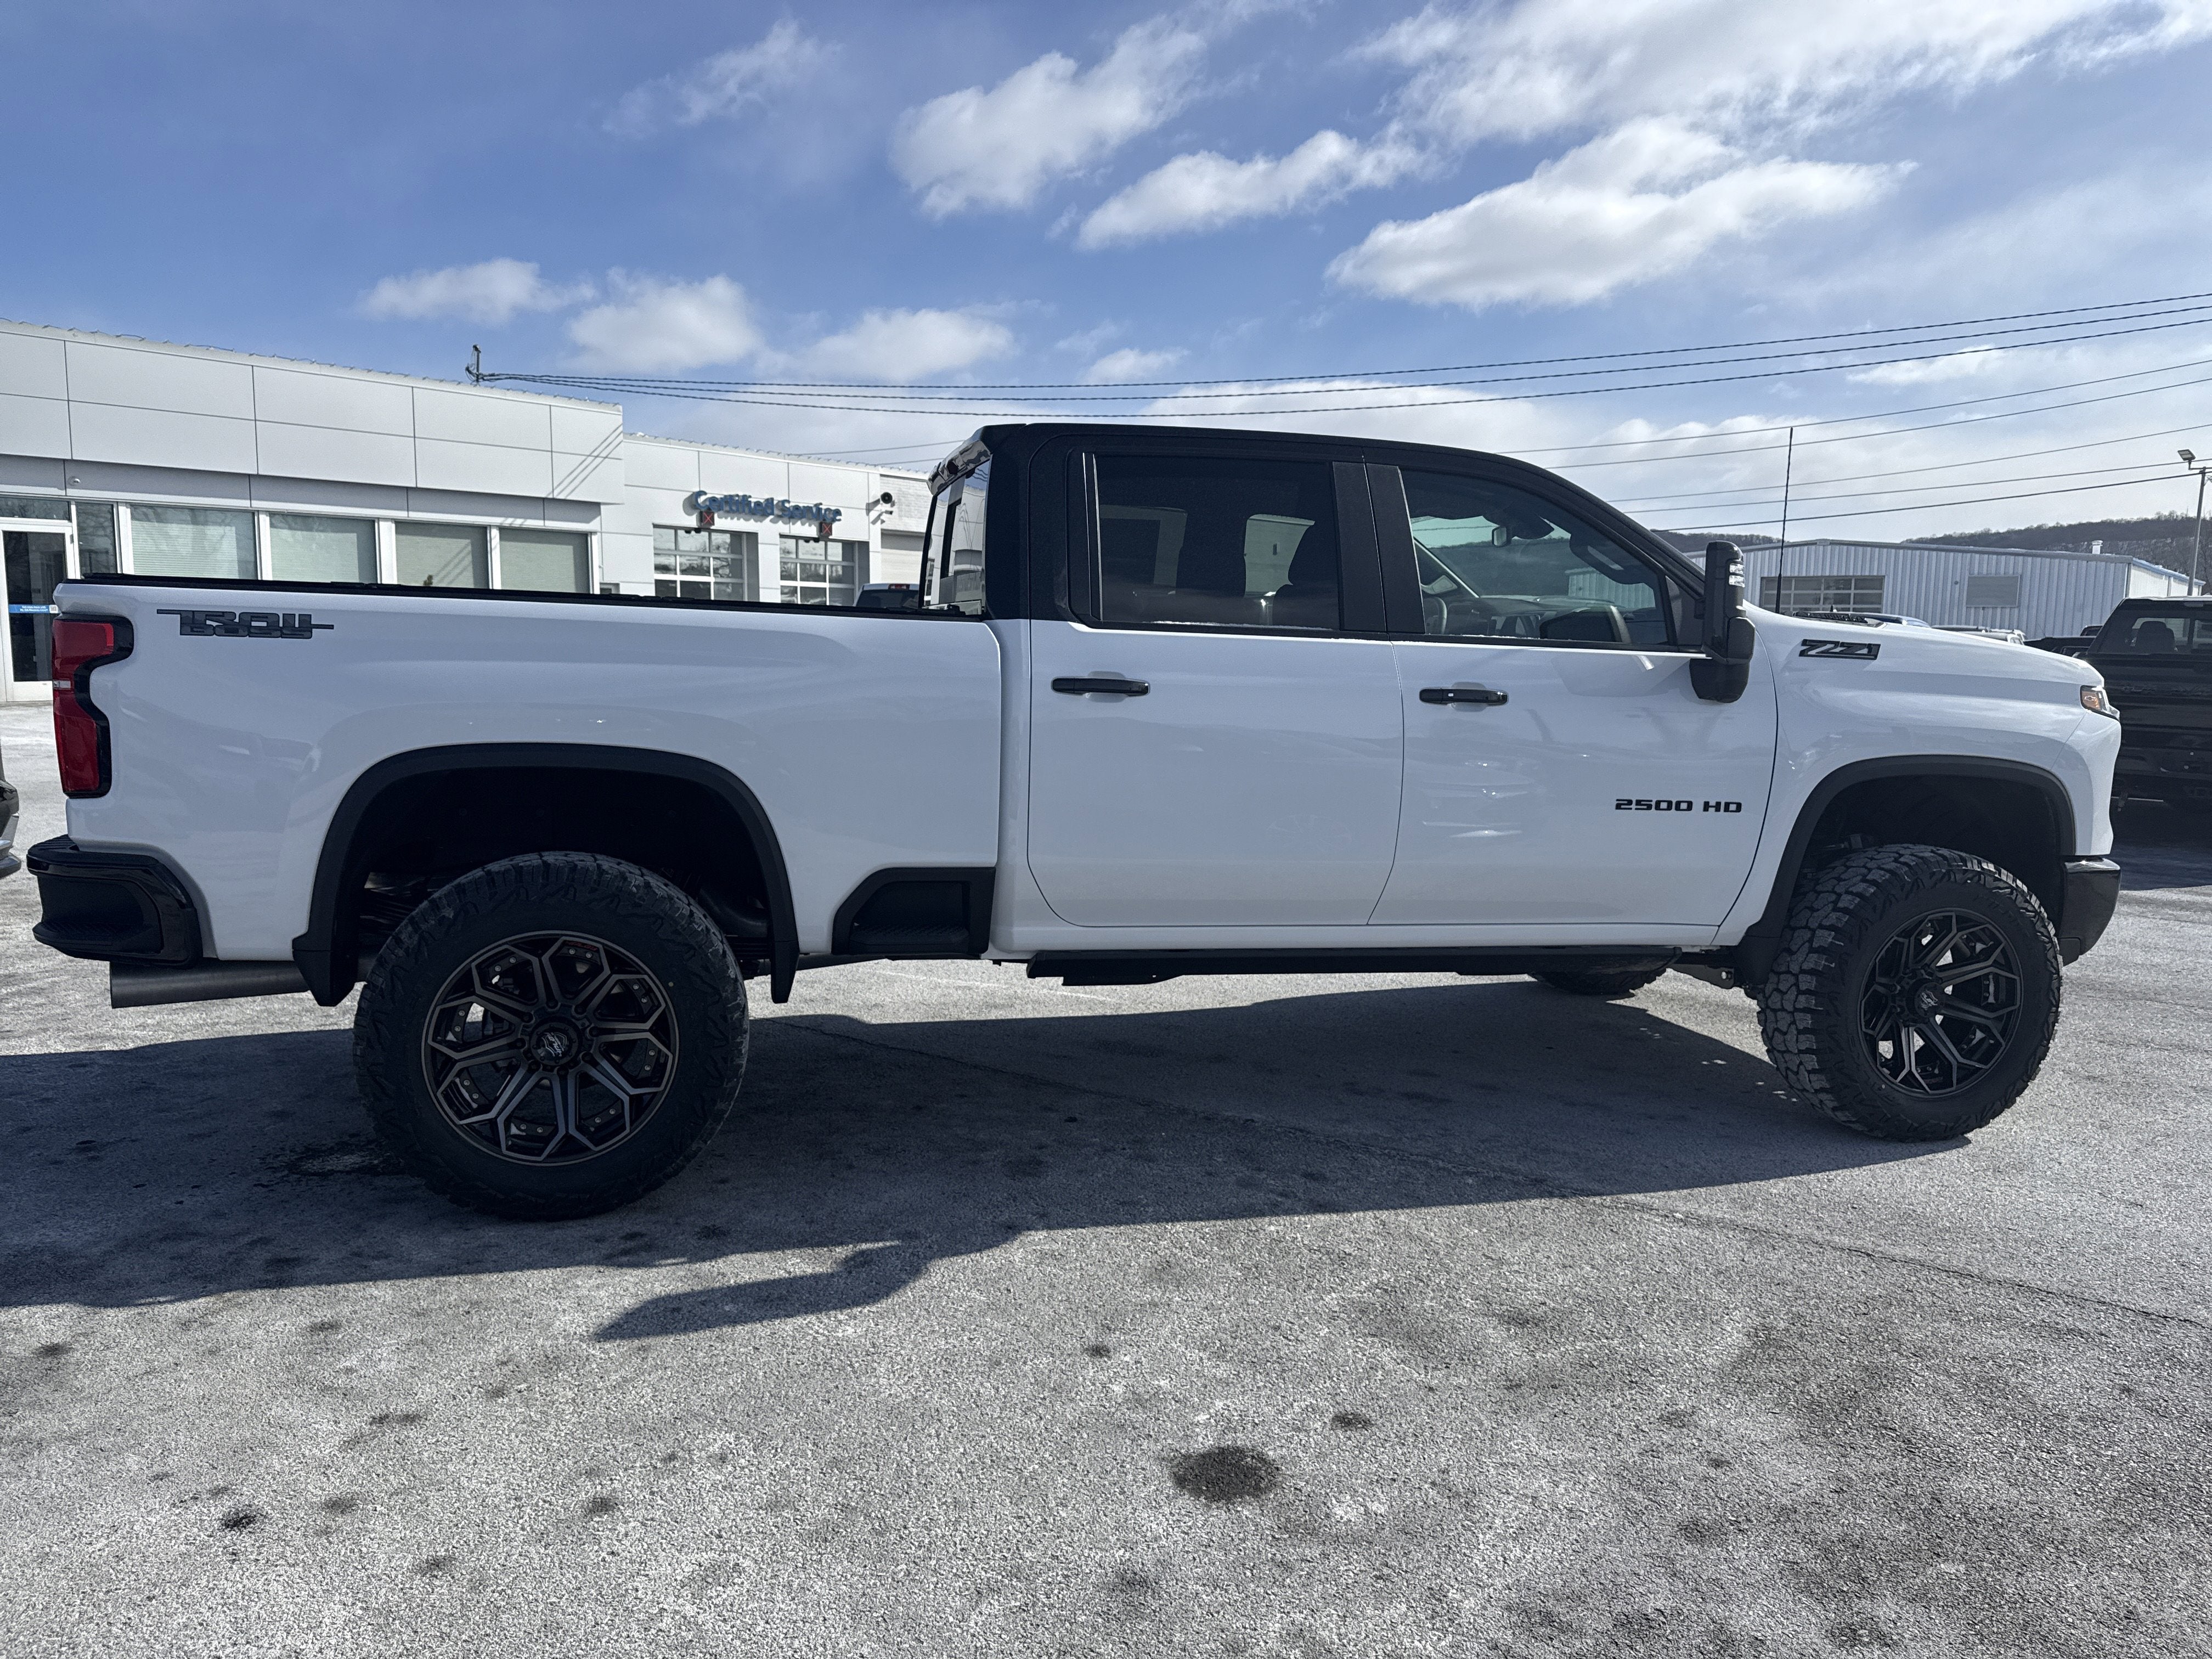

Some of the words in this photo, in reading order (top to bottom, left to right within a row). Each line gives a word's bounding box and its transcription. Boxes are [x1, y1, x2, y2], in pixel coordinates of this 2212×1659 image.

[695, 490, 774, 516] Certified
[781, 499, 842, 522] Service
[1799, 639, 1881, 660] Z71
[1615, 799, 1693, 811] 2500
[1703, 801, 1742, 812] HD
